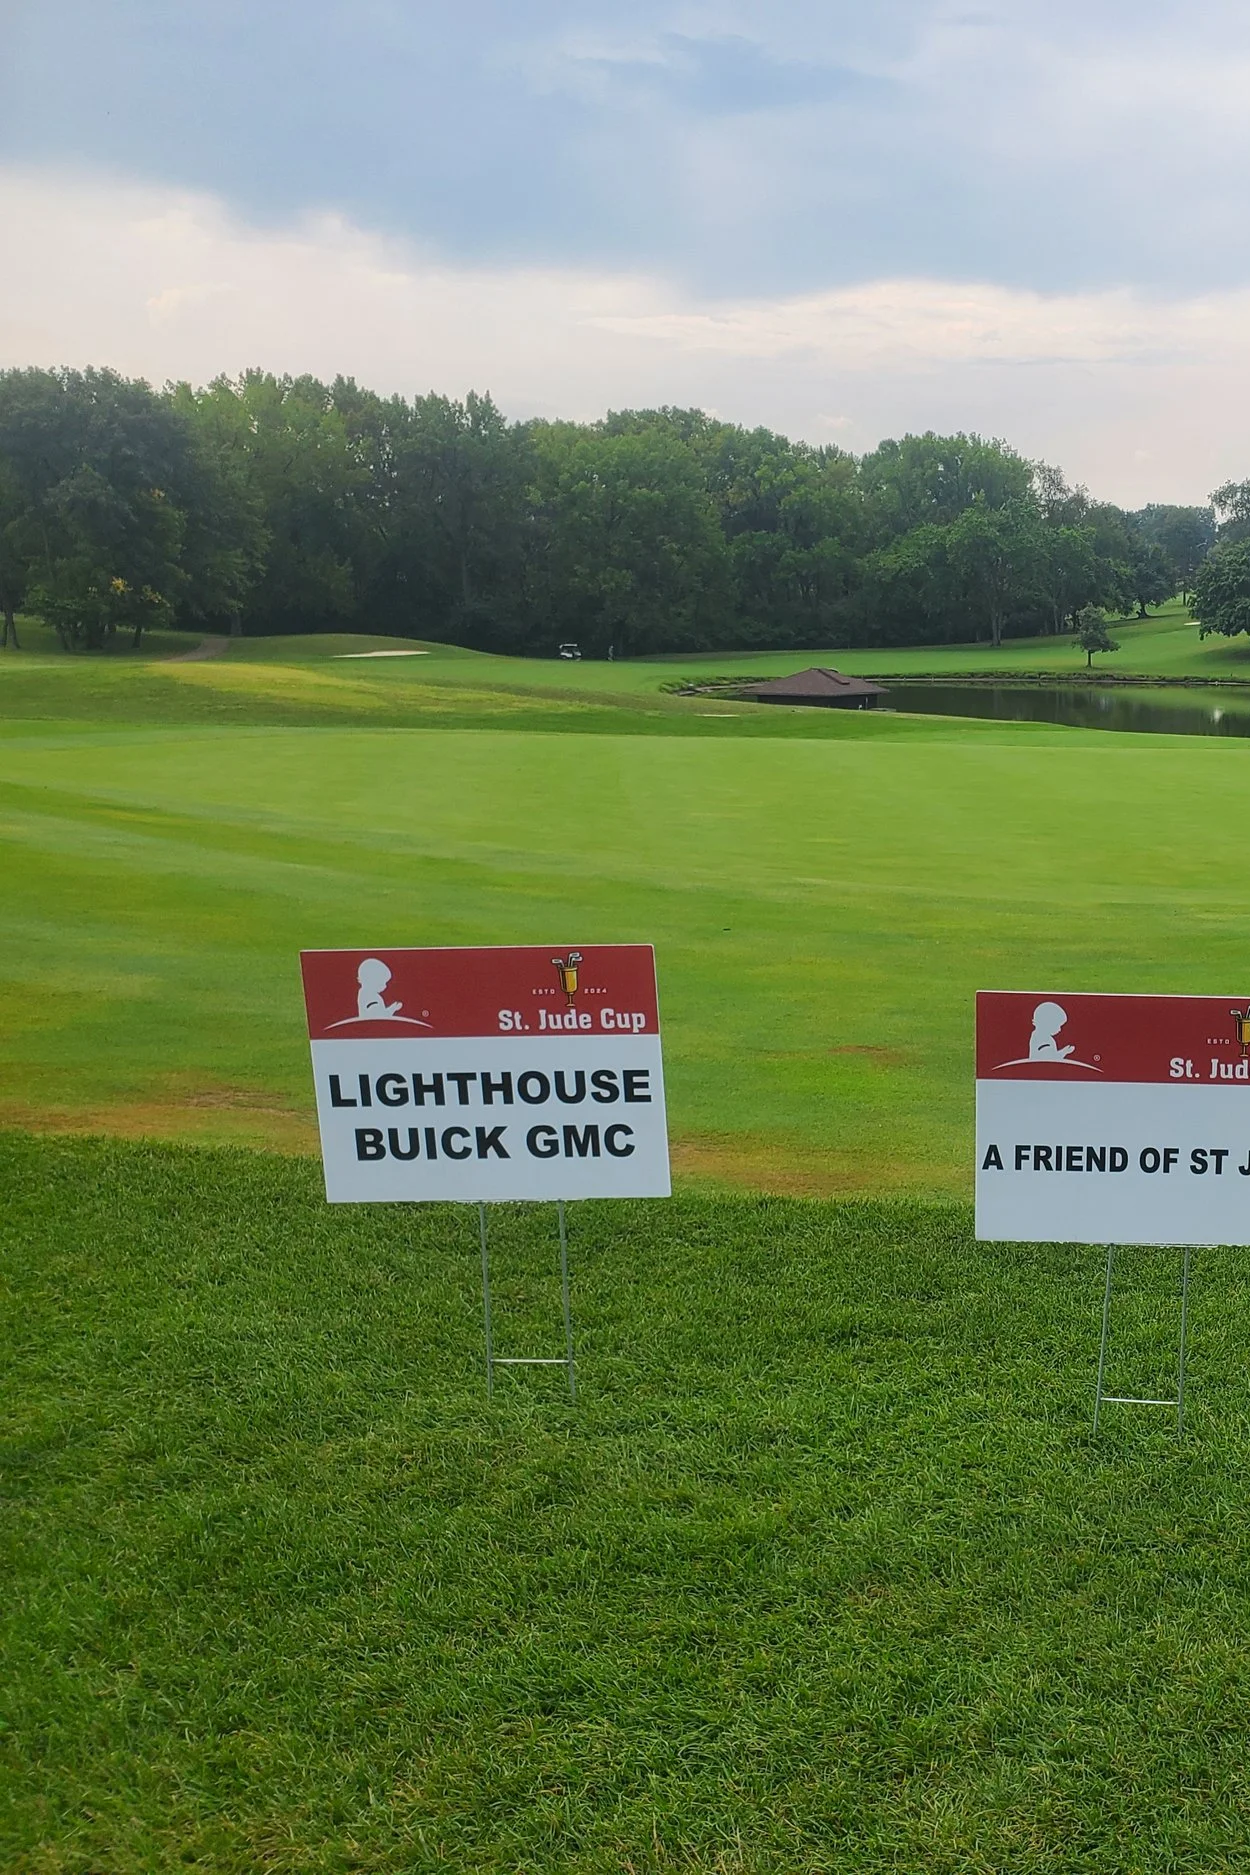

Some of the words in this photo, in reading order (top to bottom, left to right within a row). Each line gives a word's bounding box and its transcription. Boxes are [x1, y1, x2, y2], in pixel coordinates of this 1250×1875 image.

[498, 1009, 529, 1031] St.
[538, 1009, 592, 1030] Jude
[600, 1008, 646, 1033] Cup
[1169, 1057, 1200, 1079] St.
[328, 1069, 652, 1108] LIGHTHOUSE
[354, 1125, 511, 1161] BUICK
[526, 1123, 636, 1158] GMC
[982, 1144, 1004, 1170] A
[1014, 1144, 1128, 1173] FRIEND
[1139, 1147, 1179, 1174] OF
[1189, 1148, 1229, 1175] ST
